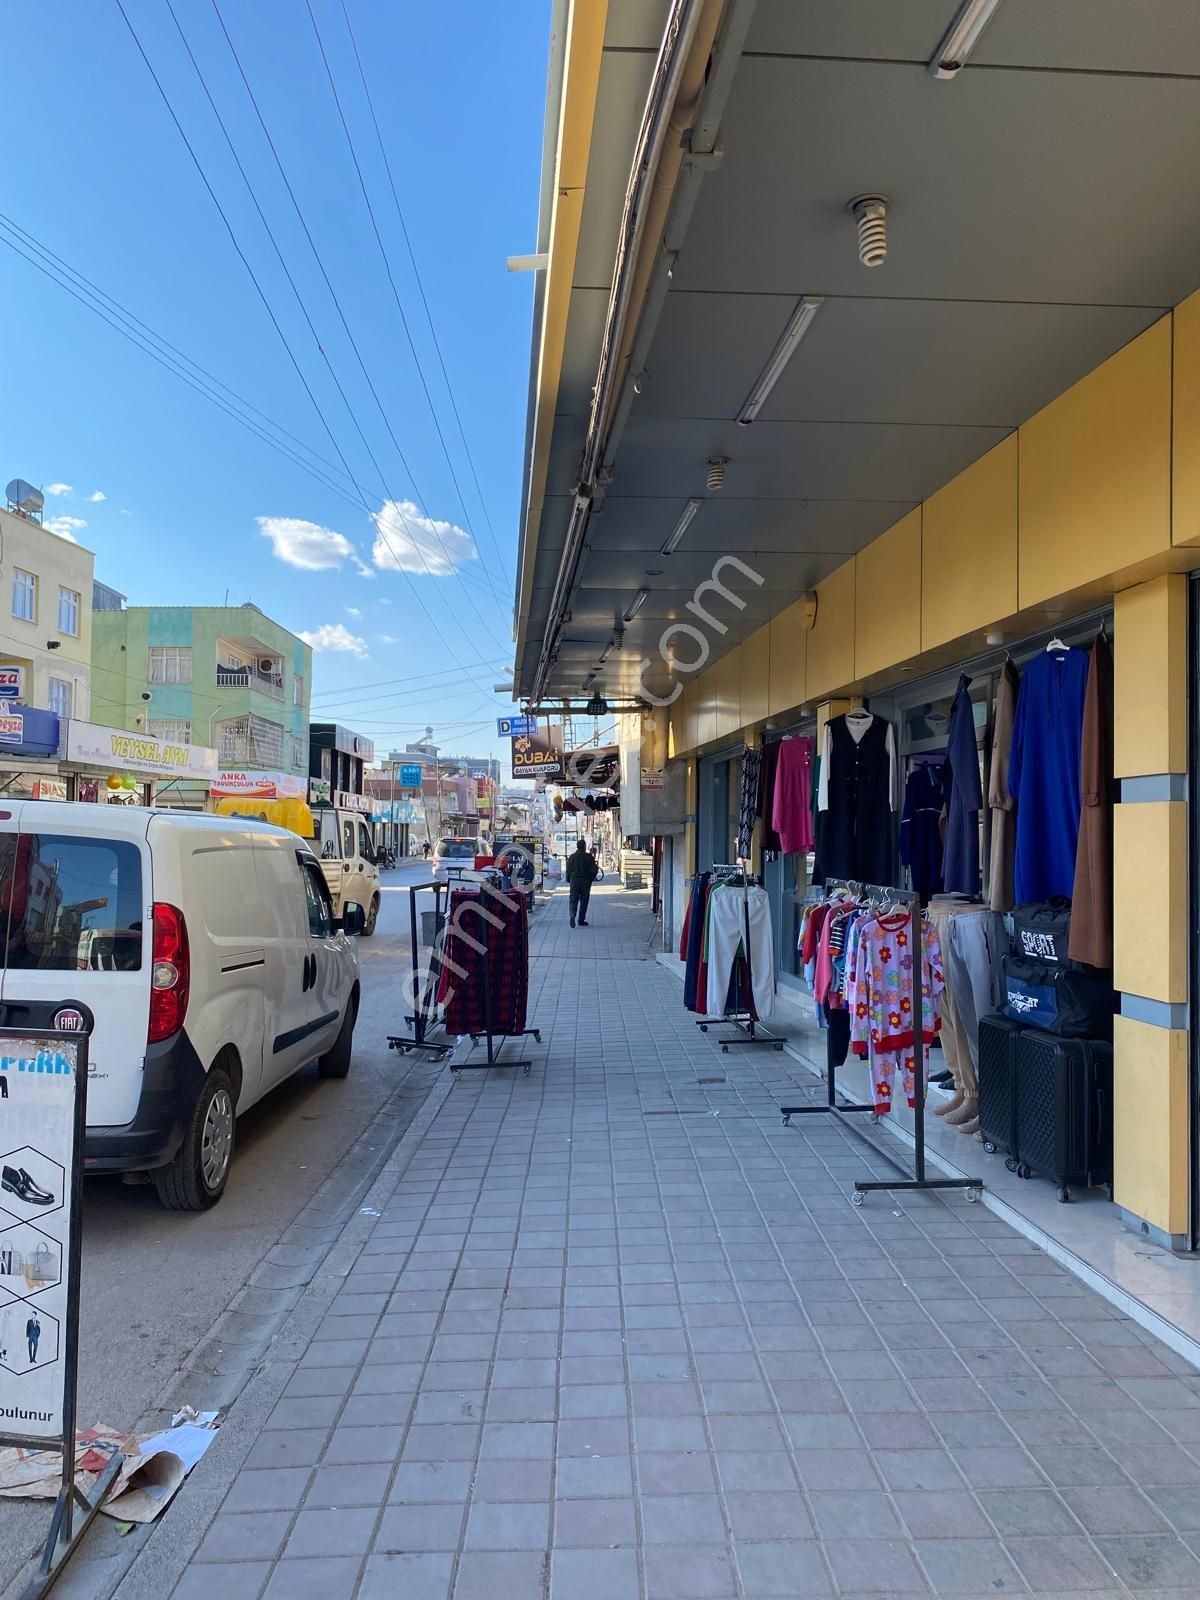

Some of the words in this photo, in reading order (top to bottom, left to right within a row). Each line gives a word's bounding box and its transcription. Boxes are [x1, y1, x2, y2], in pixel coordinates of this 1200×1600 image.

[501, 721, 510, 732] D
[111, 735, 161, 762] VEYSEL
[220, 773, 247, 781] ANKA
[60, 1017, 78, 1030] FIAT
